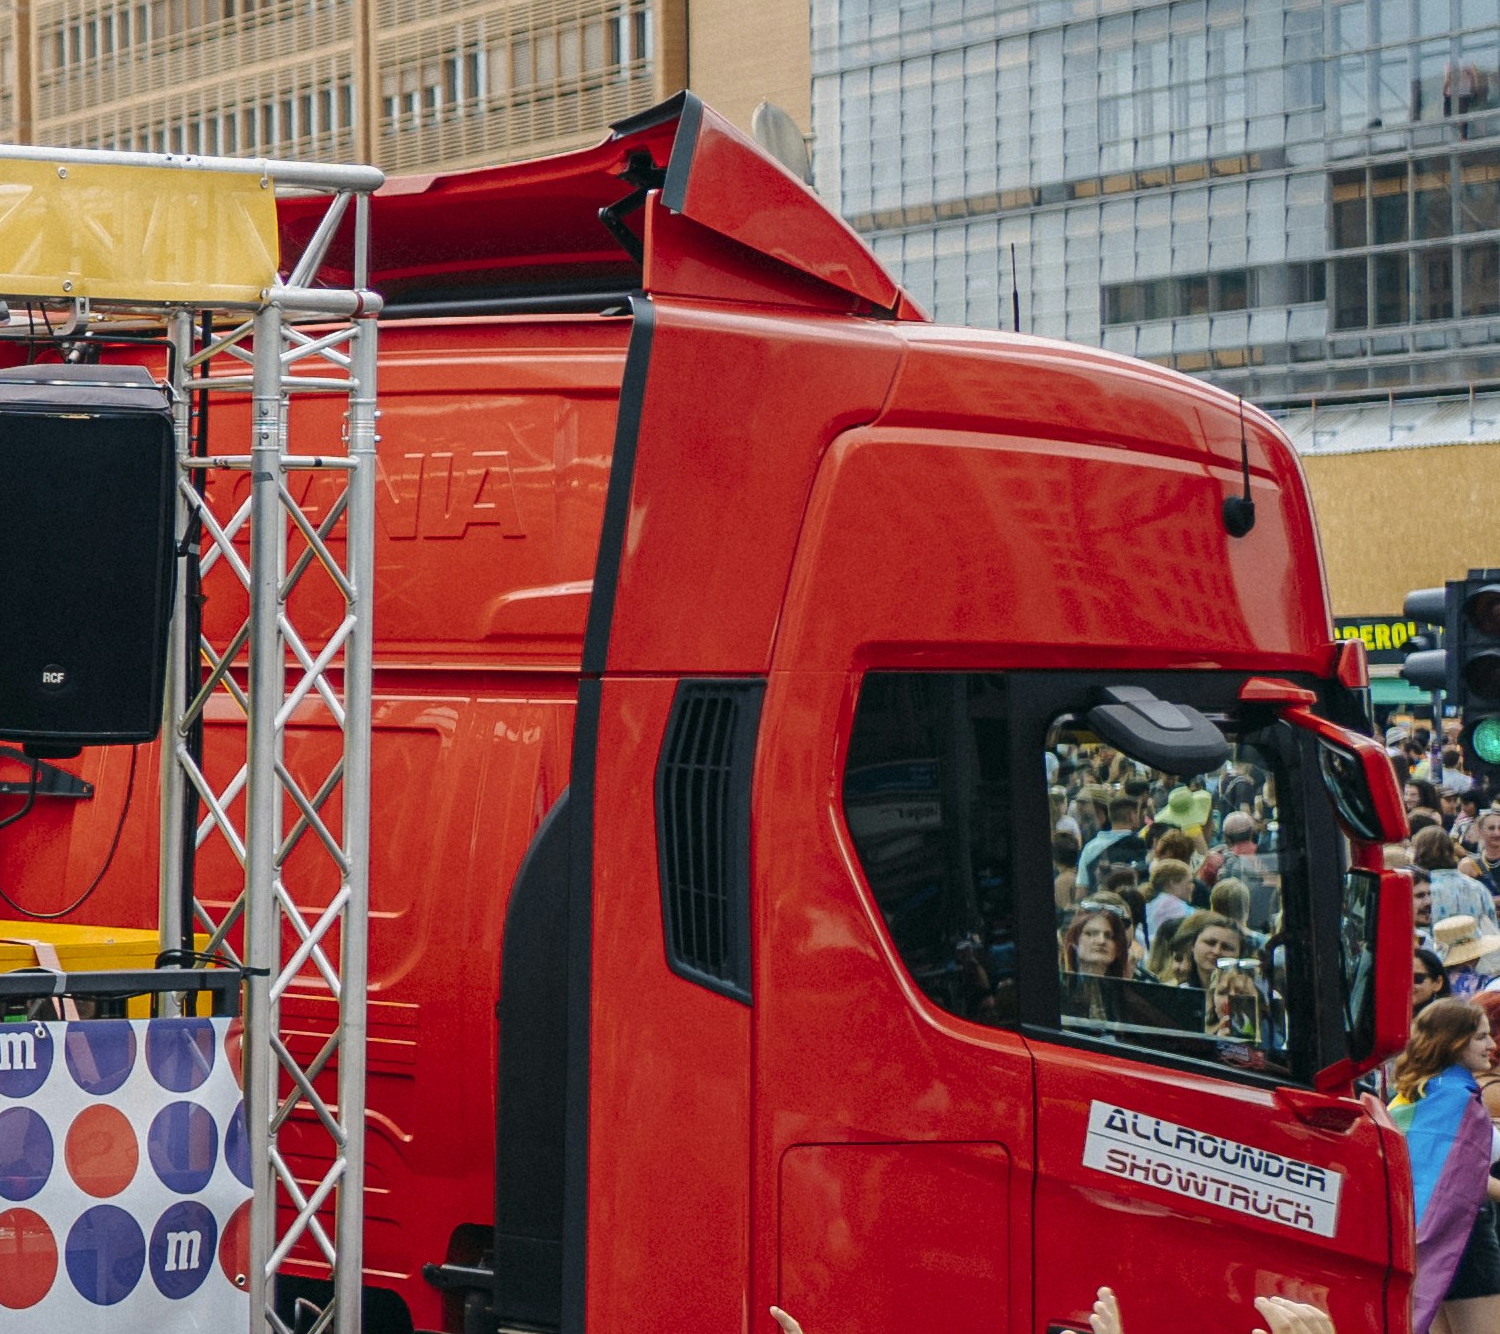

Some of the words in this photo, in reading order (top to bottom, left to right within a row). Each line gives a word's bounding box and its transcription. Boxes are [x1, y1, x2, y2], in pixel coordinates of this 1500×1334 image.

[43, 672, 64, 683] RCF
[1104, 1108, 1326, 1192] ALLROUNDER
[1104, 1148, 1314, 1229] SHOWTRUCK
[165, 1230, 201, 1271] m
